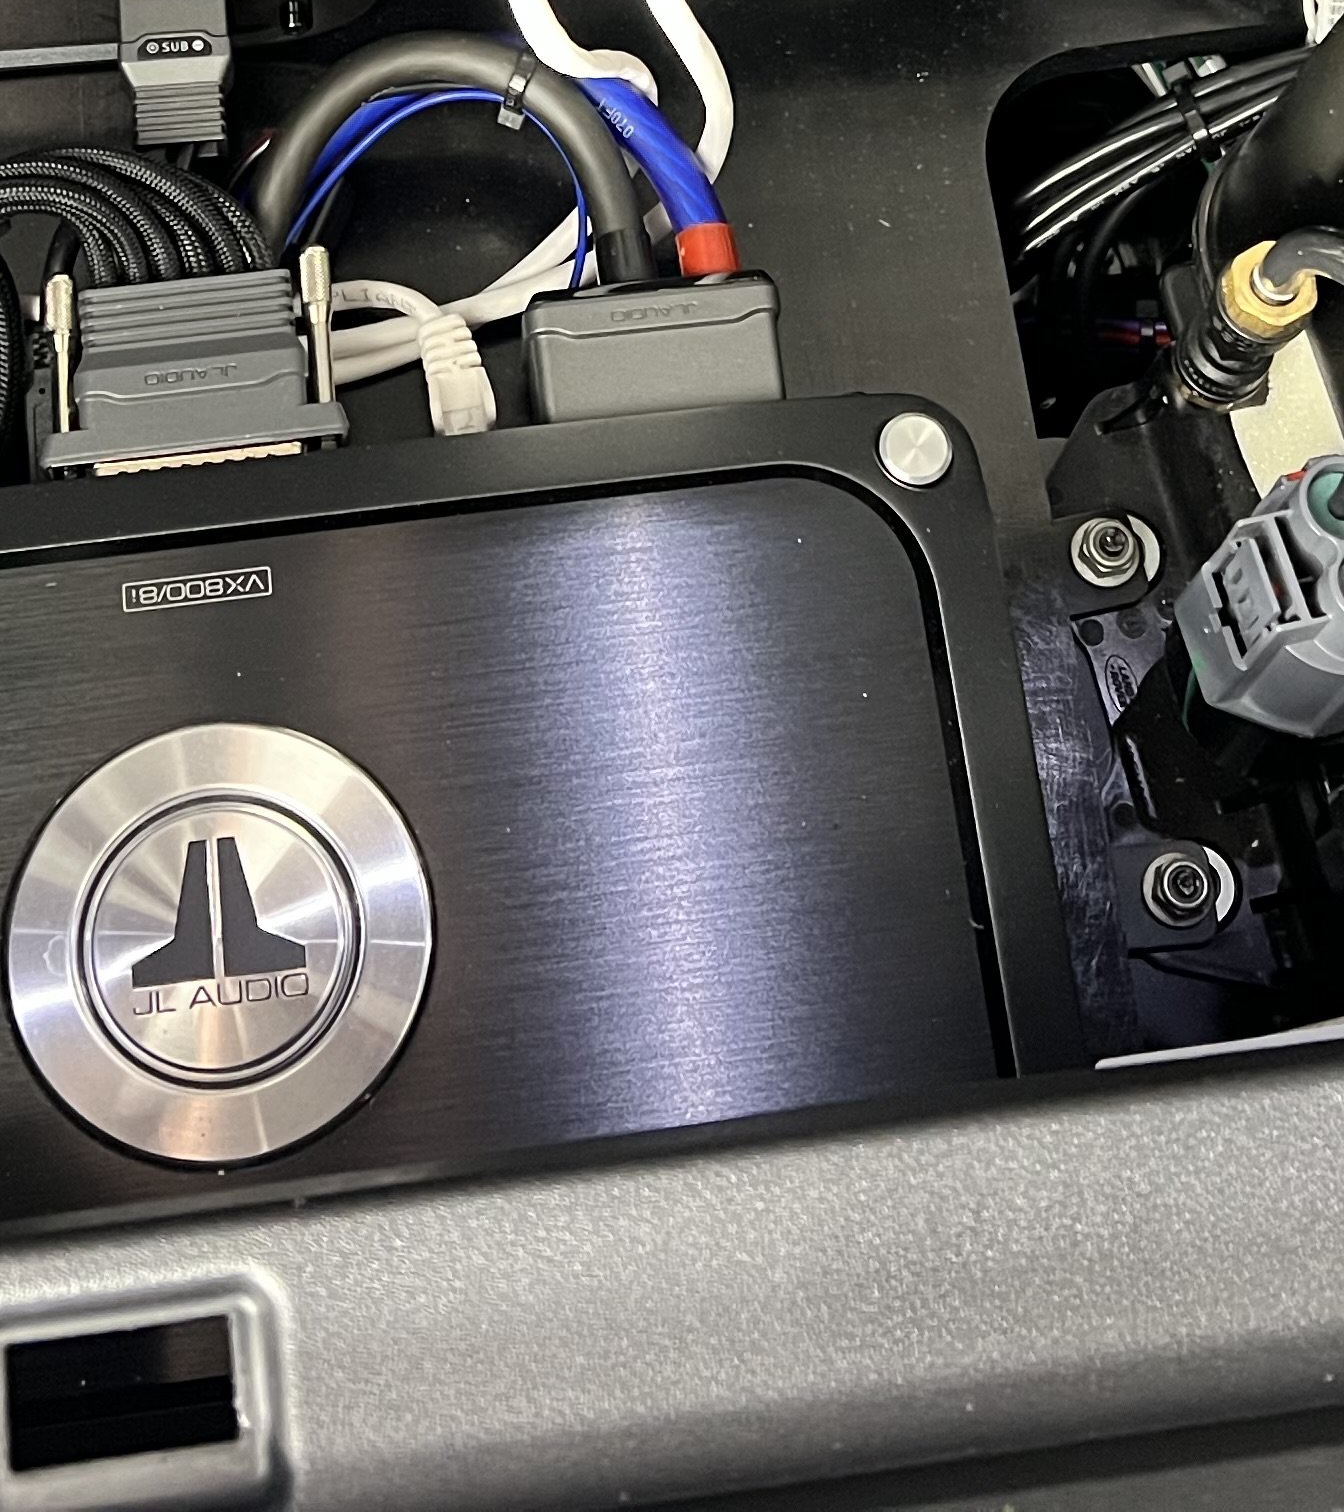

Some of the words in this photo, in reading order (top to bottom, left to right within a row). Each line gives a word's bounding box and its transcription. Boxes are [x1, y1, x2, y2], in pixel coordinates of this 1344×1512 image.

[162, 40, 189, 53] SUB
[144, 368, 207, 386] AUDIO
[211, 362, 237, 377] JL
[131, 574, 265, 604] VX800/8i
[132, 988, 177, 1016] JL
[189, 971, 309, 1010] AUDIO
